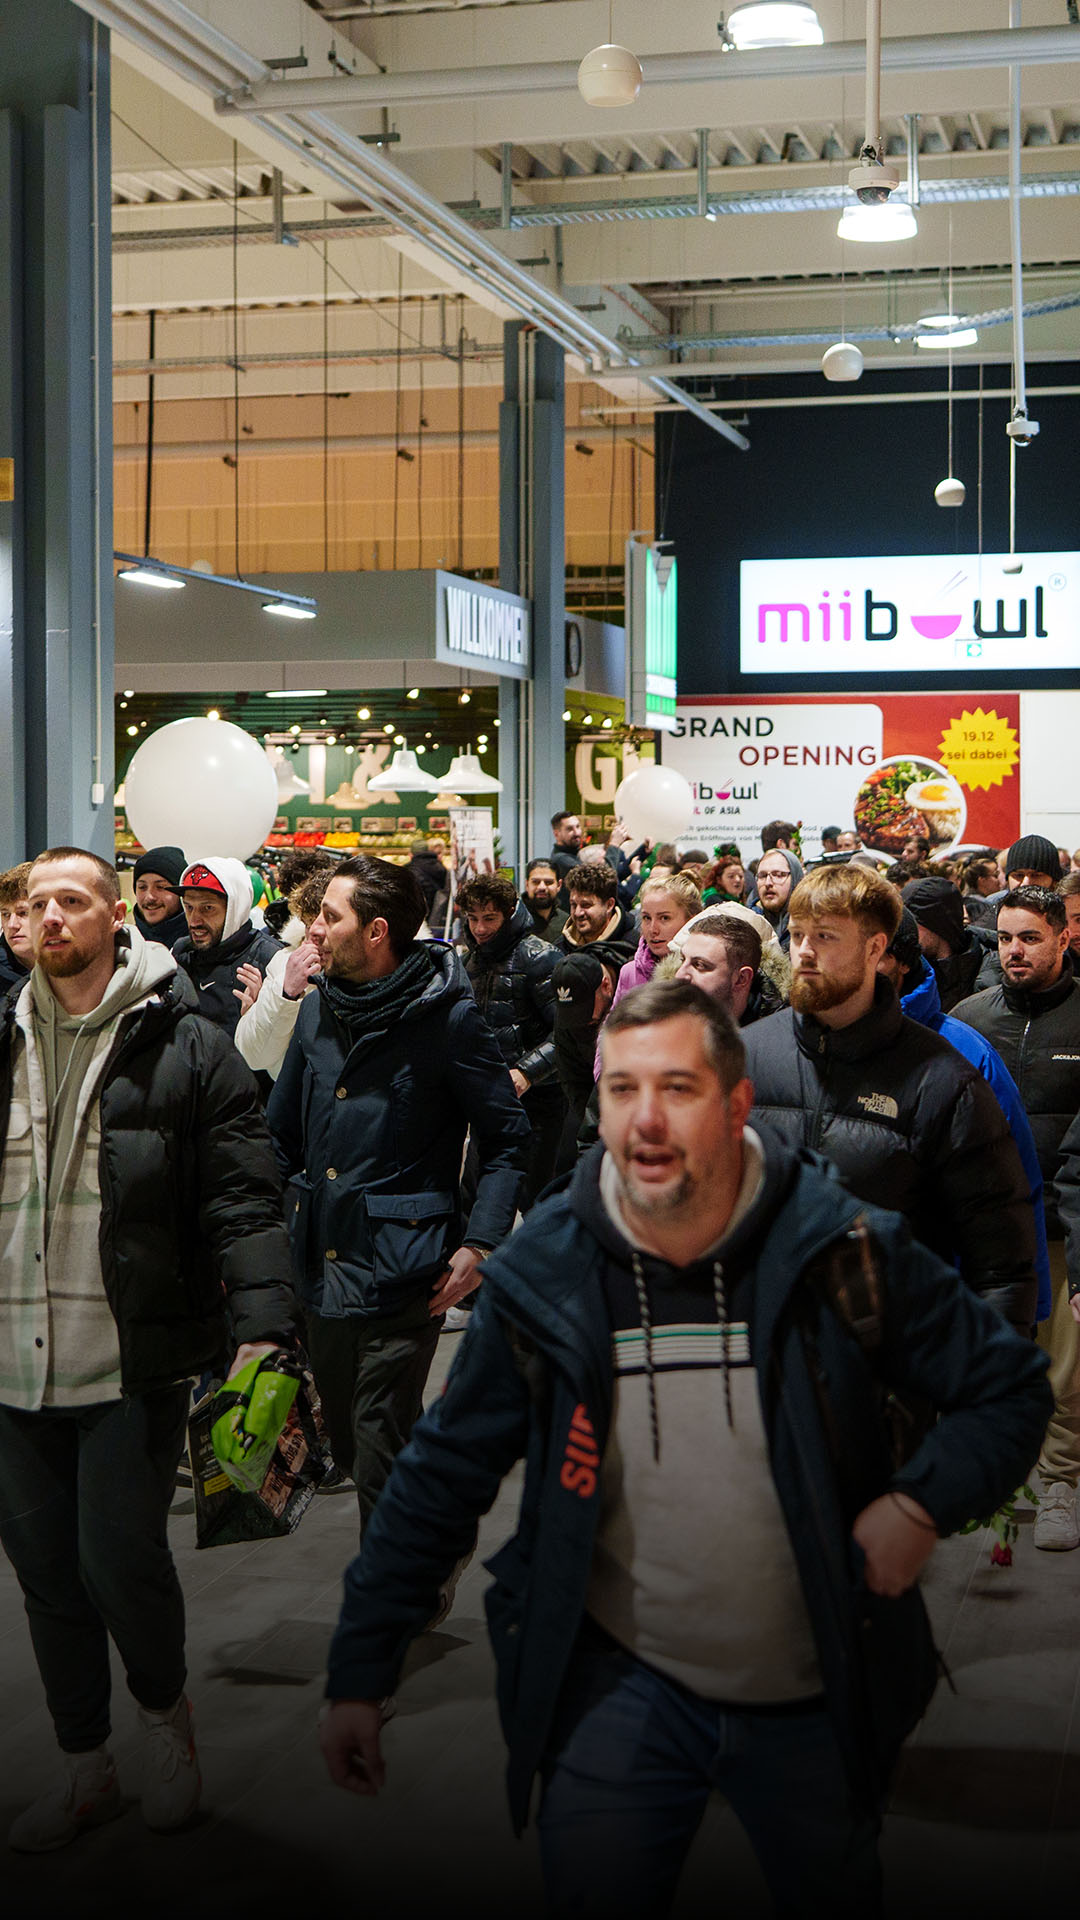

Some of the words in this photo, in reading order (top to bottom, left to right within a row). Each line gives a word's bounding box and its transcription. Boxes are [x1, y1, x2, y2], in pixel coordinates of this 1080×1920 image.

[963, 731, 995, 742] 19.12
[739, 745, 876, 767] OPENING
[947, 749, 966, 760] sei
[970, 748, 1008, 760] dabei
[704, 806, 716, 815] OF
[719, 806, 740, 815] ASIA
[857, 1095, 886, 1110] NORTH
[871, 1091, 887, 1102] THE
[864, 1103, 885, 1115] FACE
